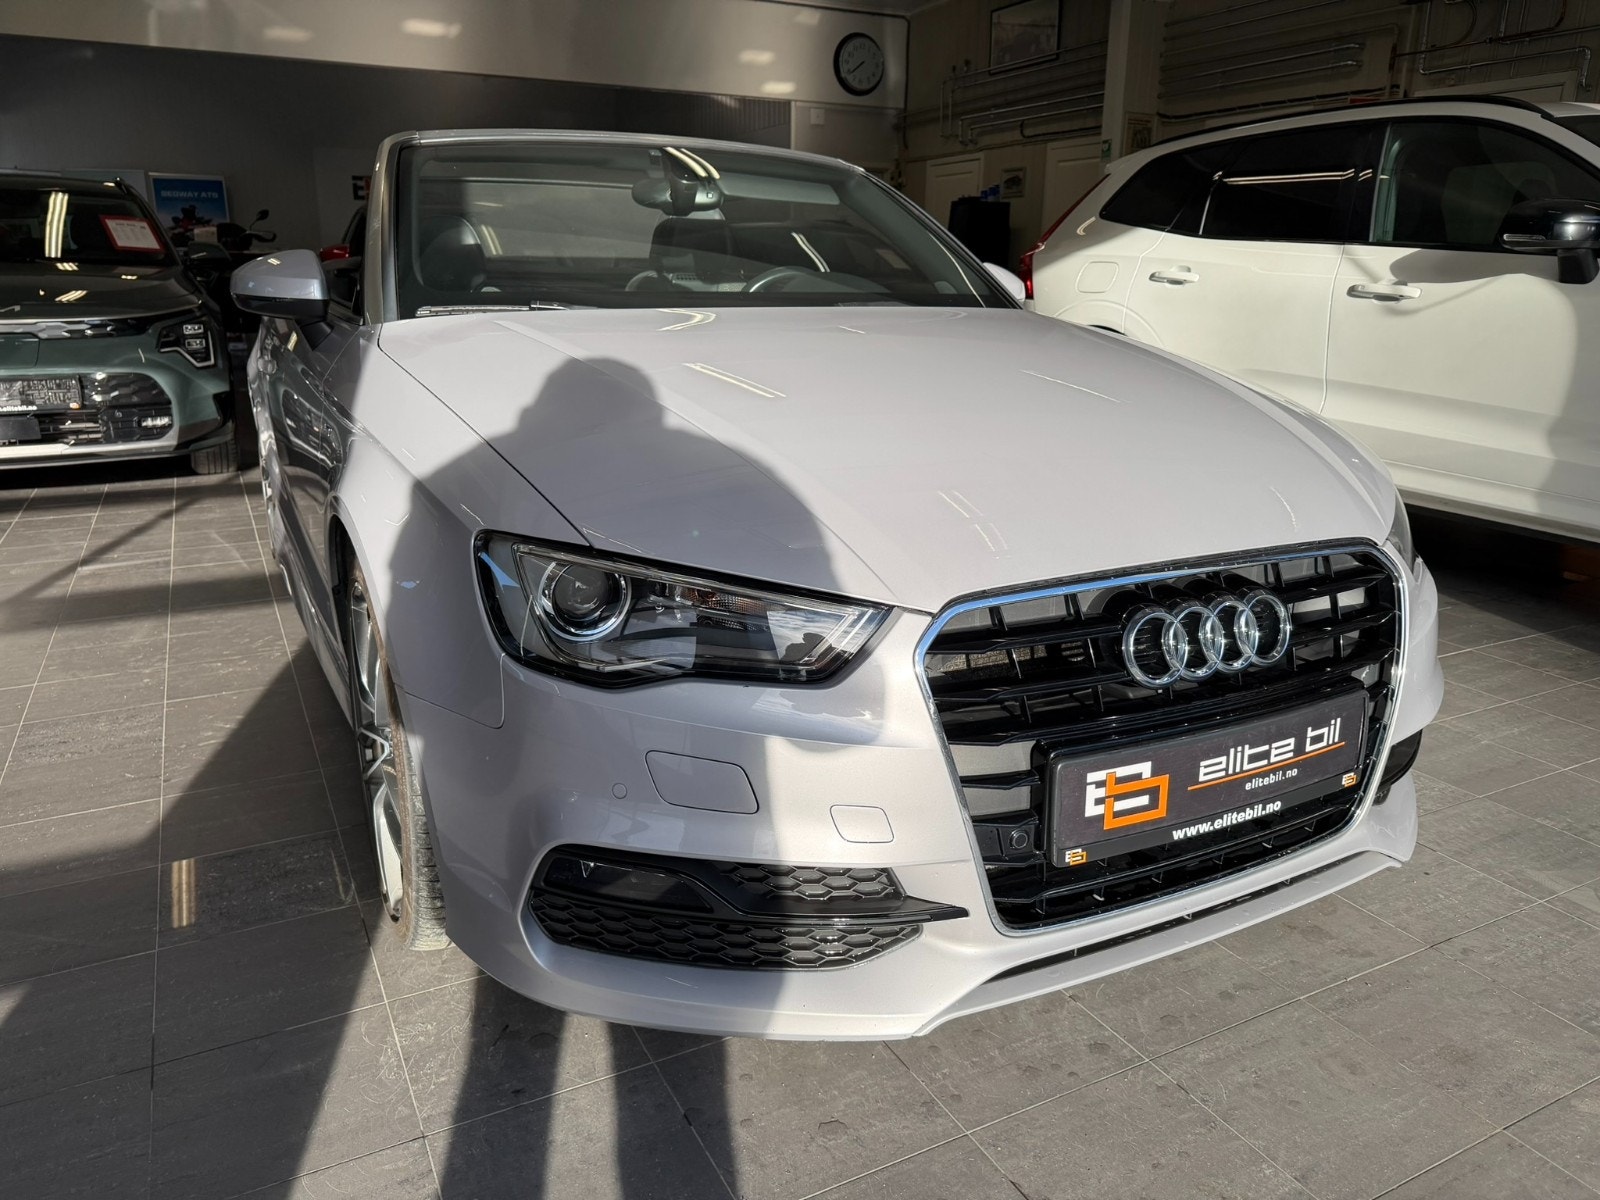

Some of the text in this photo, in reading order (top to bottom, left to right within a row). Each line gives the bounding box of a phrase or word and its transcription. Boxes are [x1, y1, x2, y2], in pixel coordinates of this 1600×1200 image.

[1198, 717, 1342, 782] elite bil
[1244, 768, 1299, 790] elitebil.no
[1171, 800, 1283, 841] www.elitebil.no
